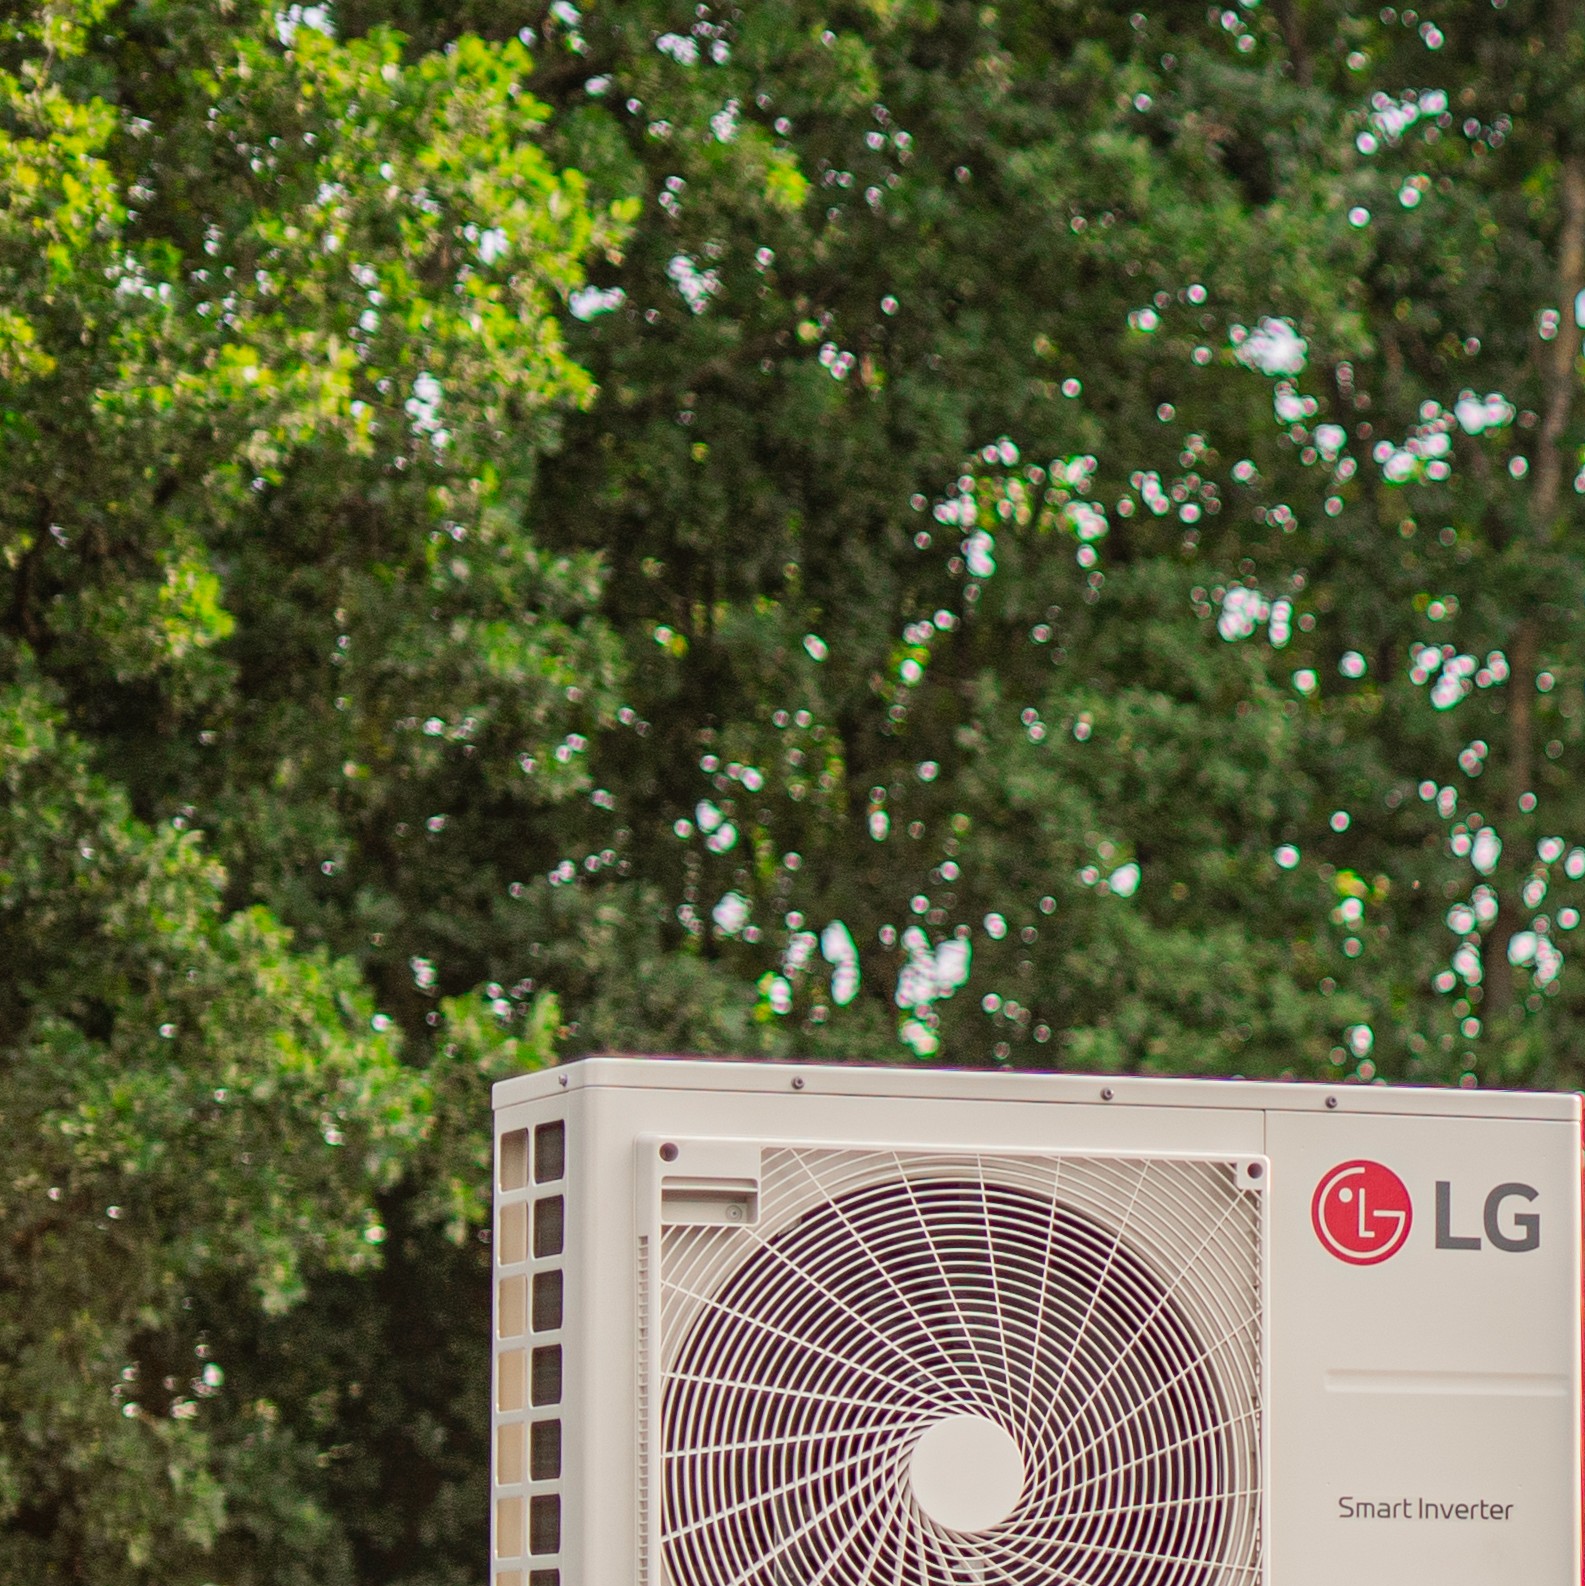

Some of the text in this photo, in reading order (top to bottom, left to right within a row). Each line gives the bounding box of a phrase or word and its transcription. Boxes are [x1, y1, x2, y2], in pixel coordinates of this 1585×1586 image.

[1435, 1181, 1540, 1252] LG
[1338, 1496, 1514, 1520] Smart Inverter
